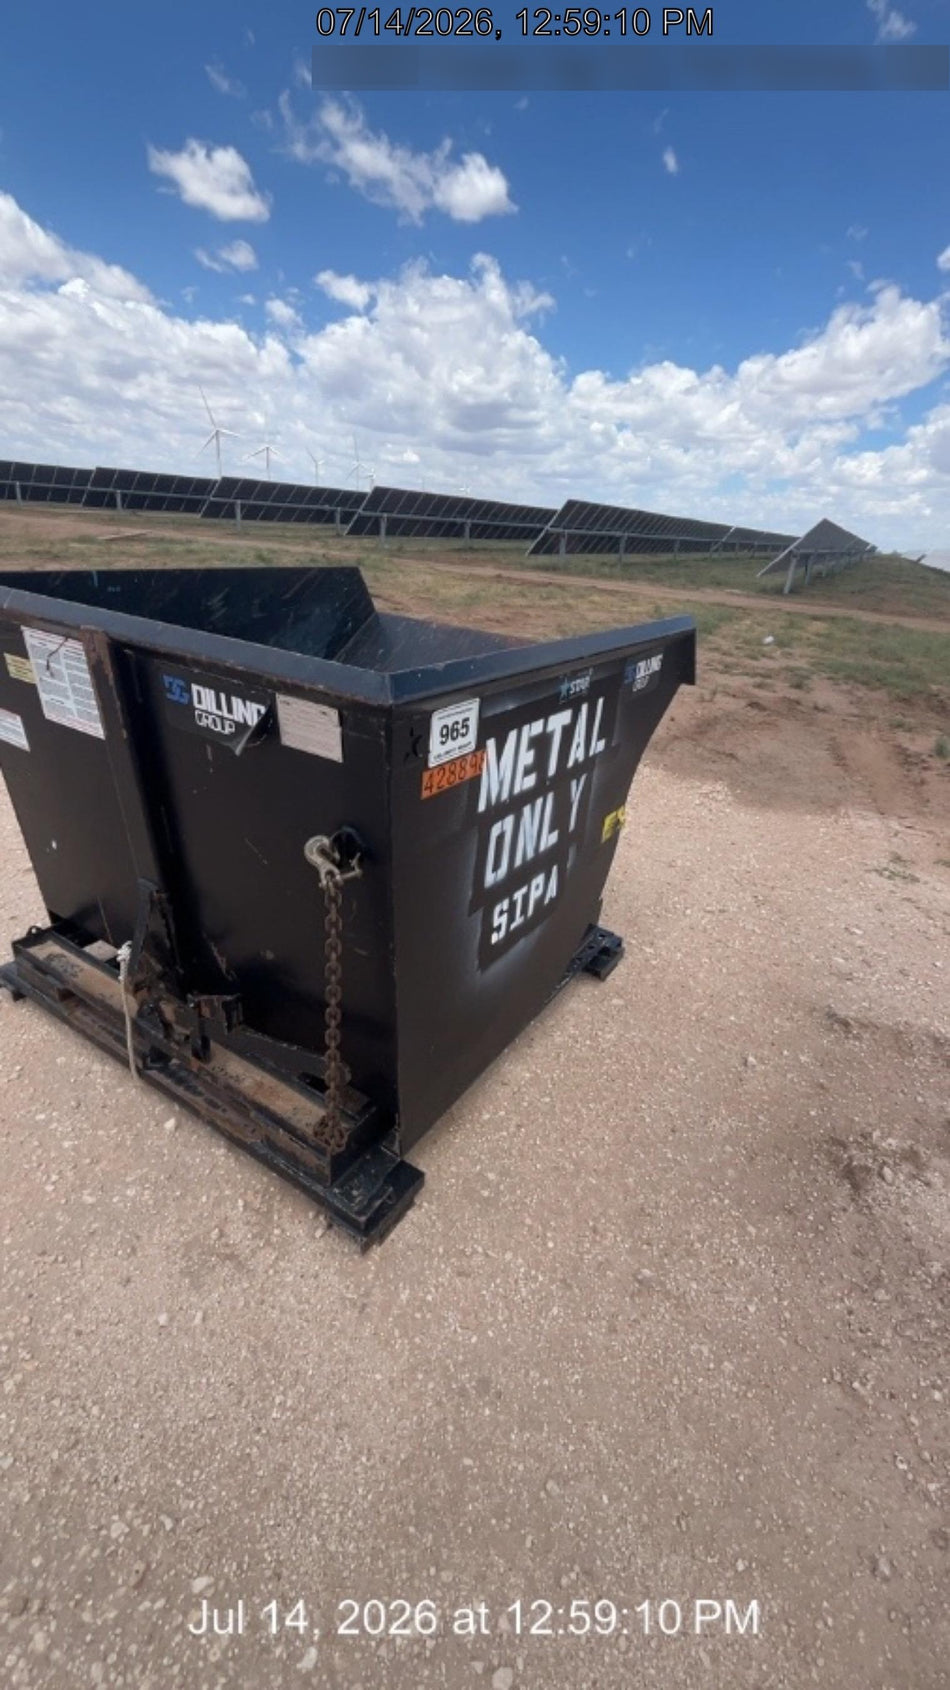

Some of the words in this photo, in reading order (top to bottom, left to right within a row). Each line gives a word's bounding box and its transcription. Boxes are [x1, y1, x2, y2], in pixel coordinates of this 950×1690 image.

[195, 709, 236, 735] GROUP
[439, 716, 471, 745] 965
[478, 696, 606, 813] METAL
[484, 773, 587, 889] ONLY
[491, 864, 558, 945] SIPA
